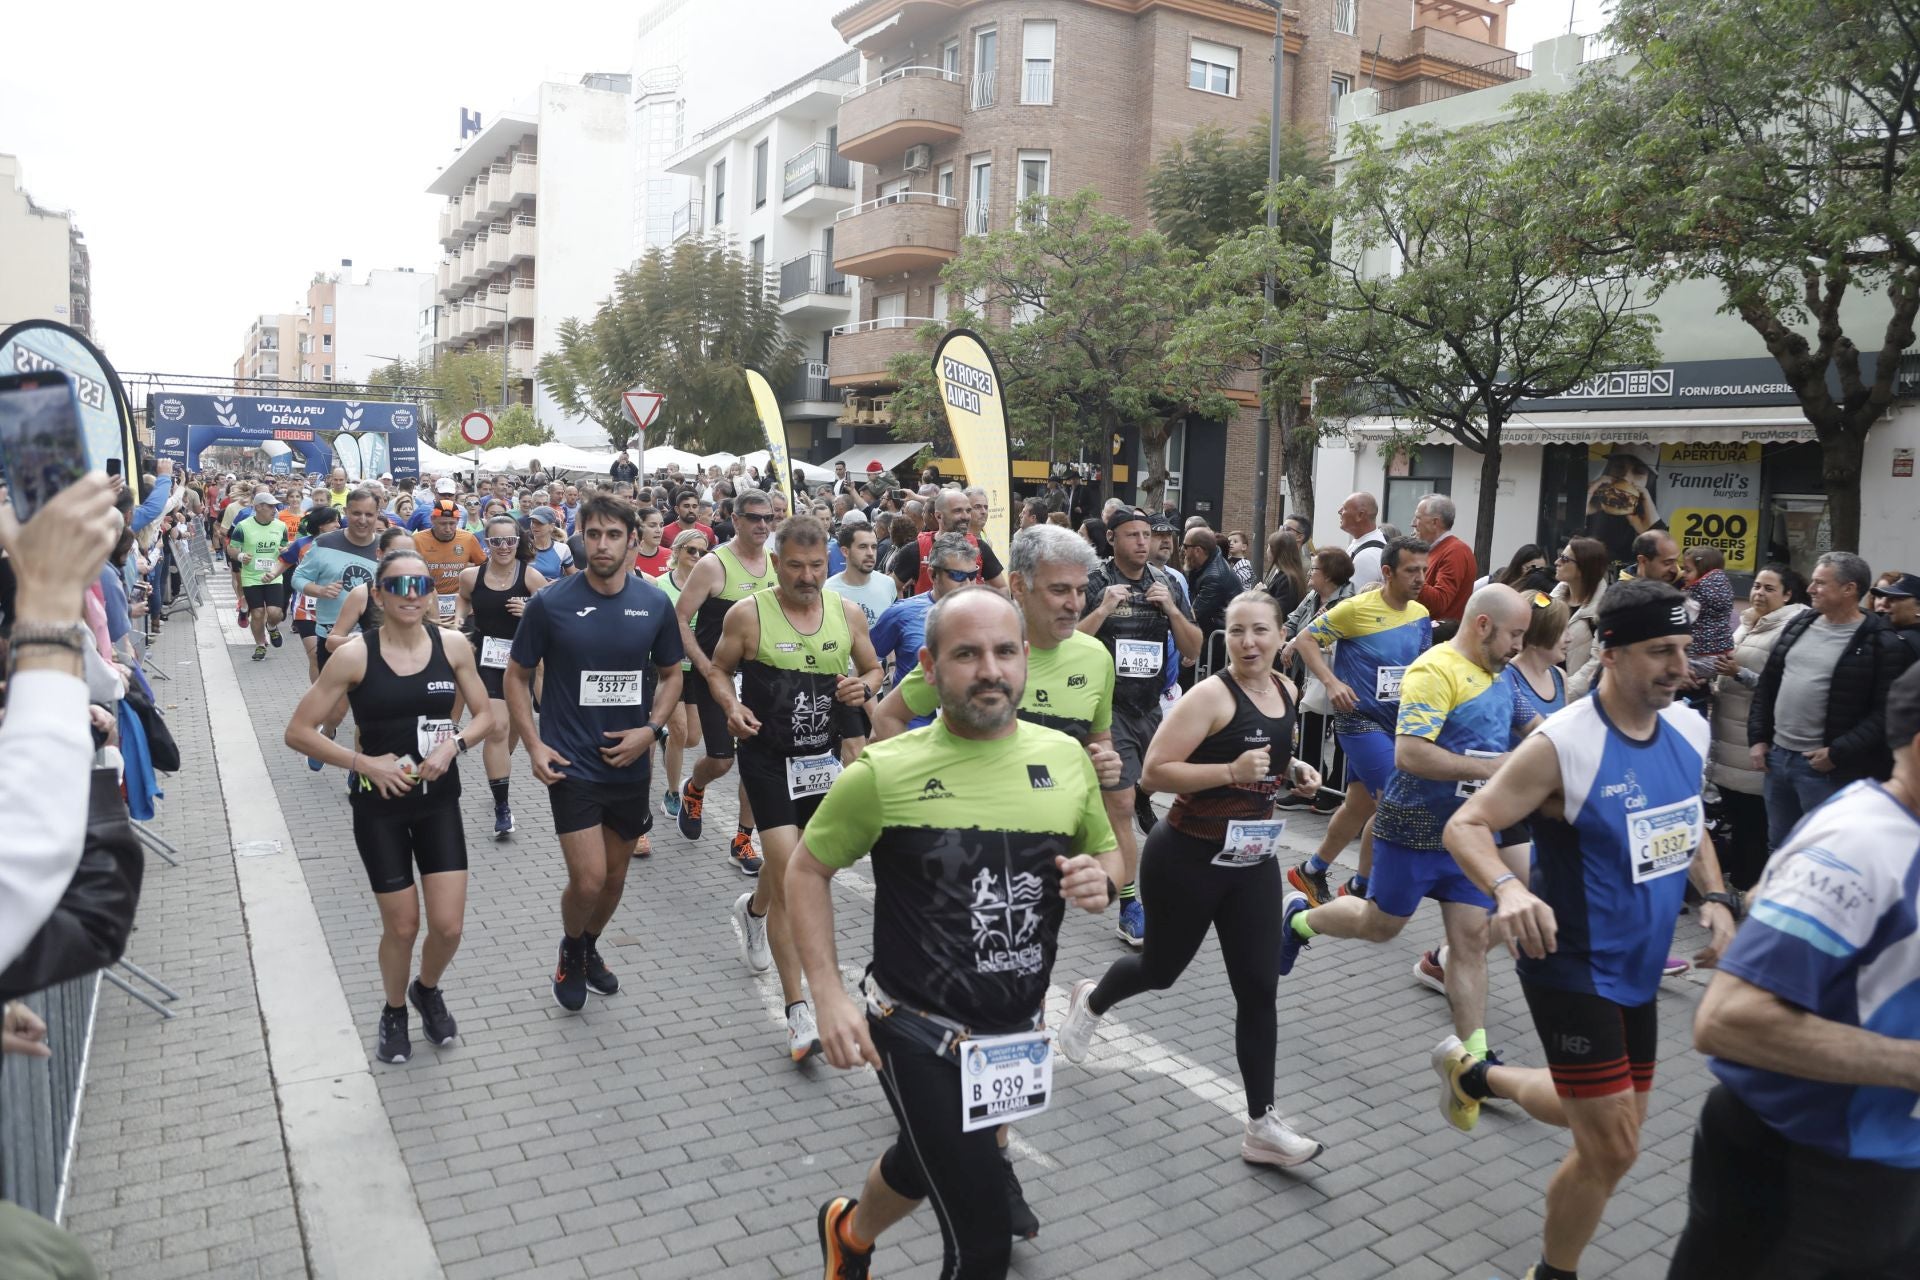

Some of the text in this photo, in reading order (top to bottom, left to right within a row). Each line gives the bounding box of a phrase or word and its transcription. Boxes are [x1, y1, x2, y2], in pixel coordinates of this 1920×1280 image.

[461, 107, 481, 139] H
[257, 404, 291, 413] VOLTA
[304, 407, 325, 415] PEU
[271, 414, 311, 426] DÉNIA
[1742, 430, 1798, 439] PuraMasa
[1672, 450, 1748, 461] APERTURA
[1669, 472, 1749, 489] Fanneli's
[1714, 489, 1749, 499] burgers
[1684, 513, 1747, 539] 200
[258, 541, 275, 549] SLP
[1683, 537, 1745, 549] BURGERS
[1122, 658, 1149, 668] A 482
[598, 682, 626, 692] 3527
[796, 772, 831, 784] E 973
[1641, 833, 1685, 859] C 1337
[973, 1075, 1023, 1102] B 939
[988, 1096, 1029, 1115] BALEARIA
